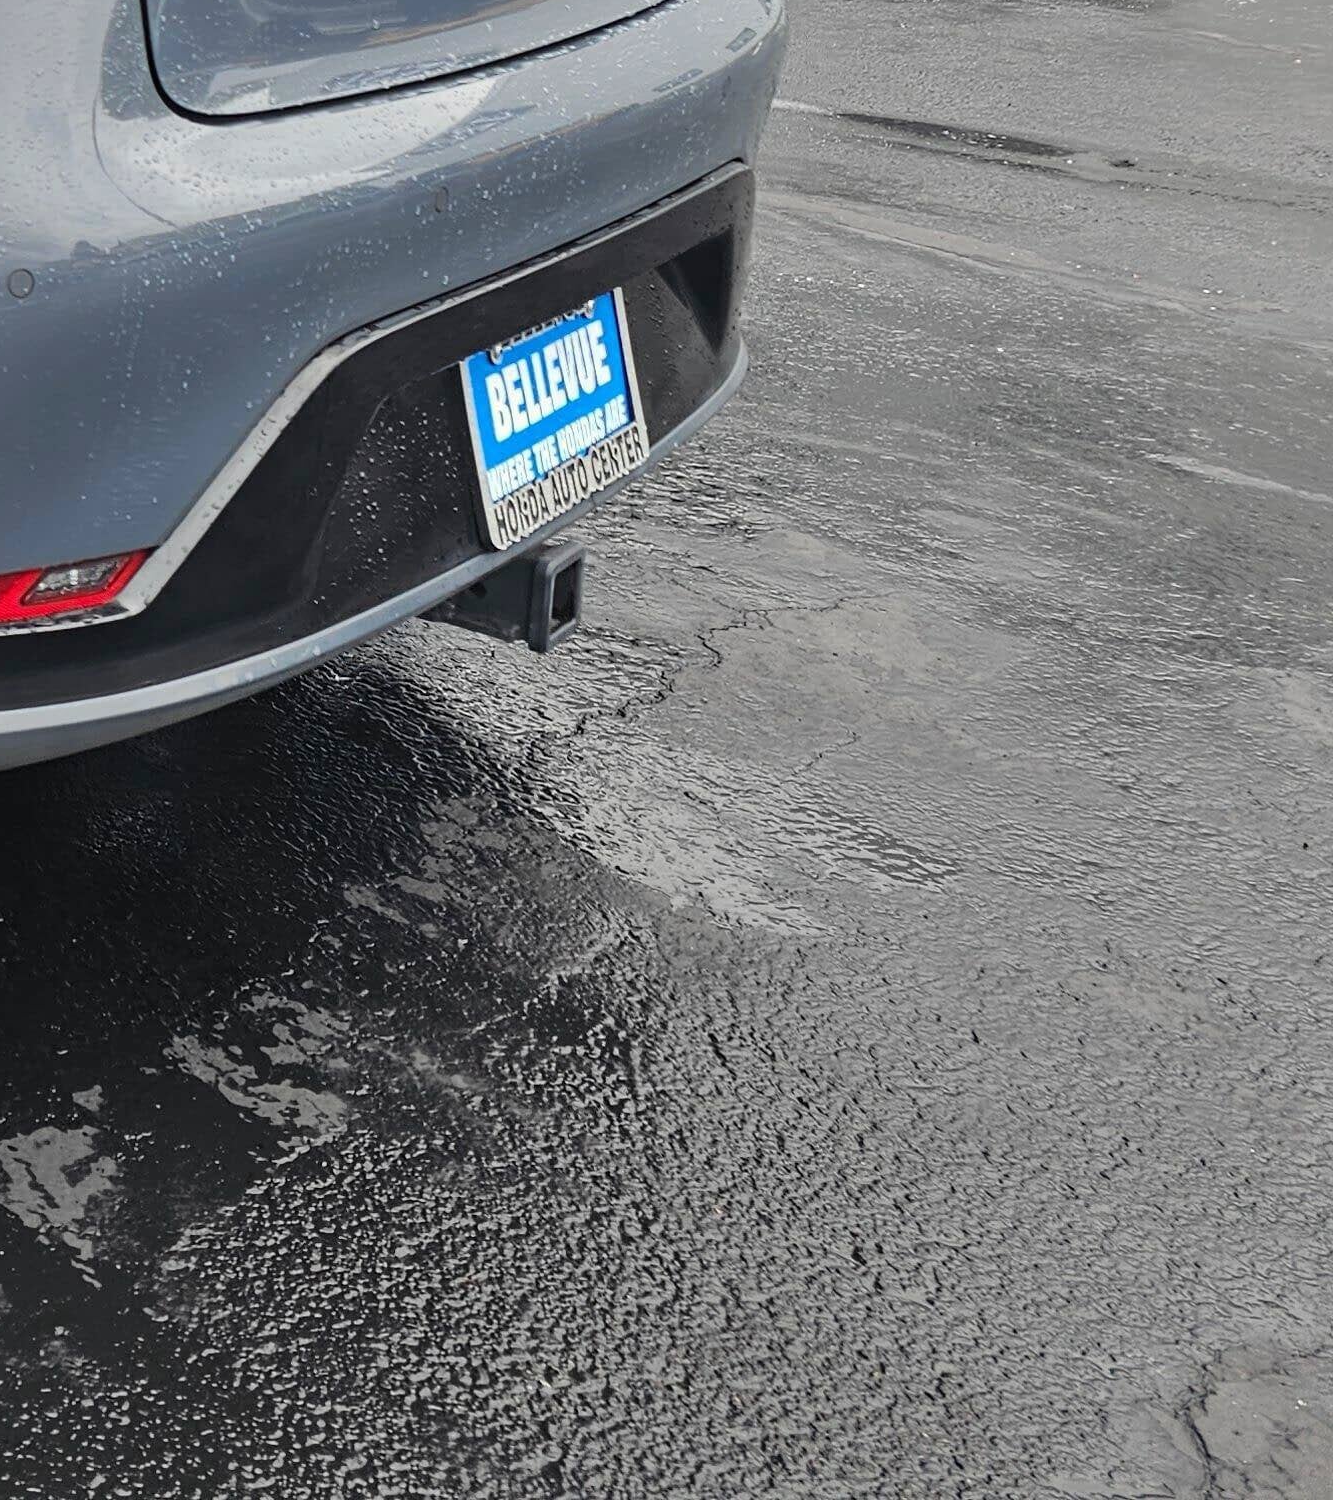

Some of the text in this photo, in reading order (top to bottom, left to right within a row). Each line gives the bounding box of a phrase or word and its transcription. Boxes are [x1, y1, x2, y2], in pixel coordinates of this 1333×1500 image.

[485, 319, 612, 442] BELLEVUE
[487, 448, 536, 501] WHERE
[532, 434, 561, 480] THE
[493, 426, 645, 545] HONDA AUTO CENTER
